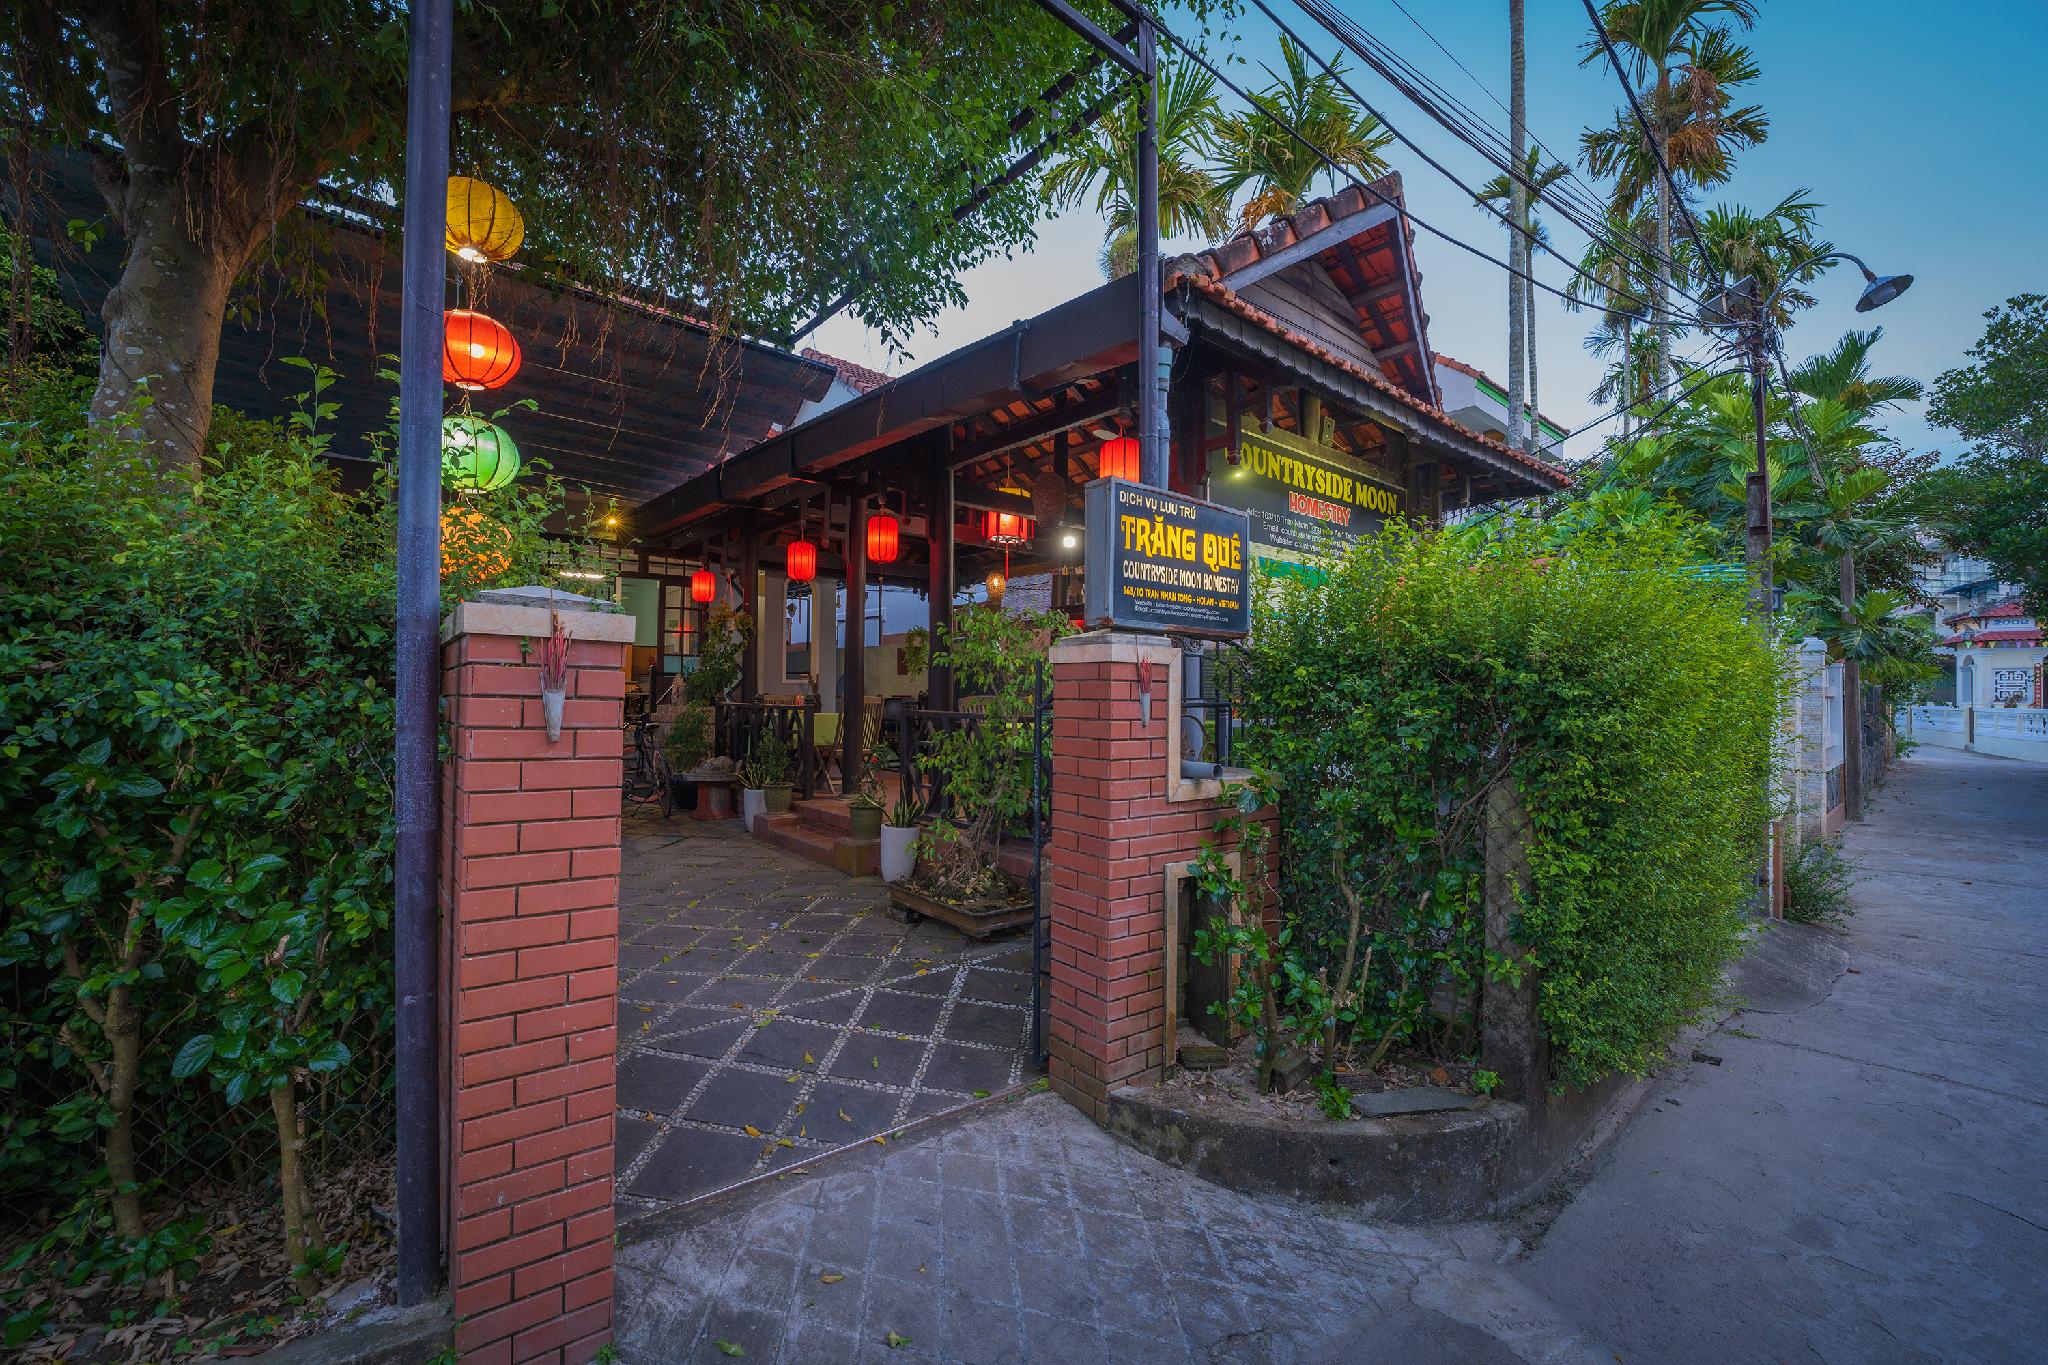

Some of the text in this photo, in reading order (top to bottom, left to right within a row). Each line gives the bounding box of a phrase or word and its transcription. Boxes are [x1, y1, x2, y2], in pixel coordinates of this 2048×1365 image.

[1225, 441, 1398, 516] OUNTRYSIDE MOON
[1120, 491, 1143, 507] DỊCH
[1145, 496, 1158, 513] VỤ
[1179, 504, 1196, 520] TRÚ
[1288, 490, 1351, 527] HOMESTAY
[1121, 514, 1196, 562] TRĂNG
[1203, 533, 1242, 572] QUÊ
[1123, 560, 1240, 595] COUNTRYSIDE MOON HOMESTAY
[1144, 587, 1159, 600] TRAN
